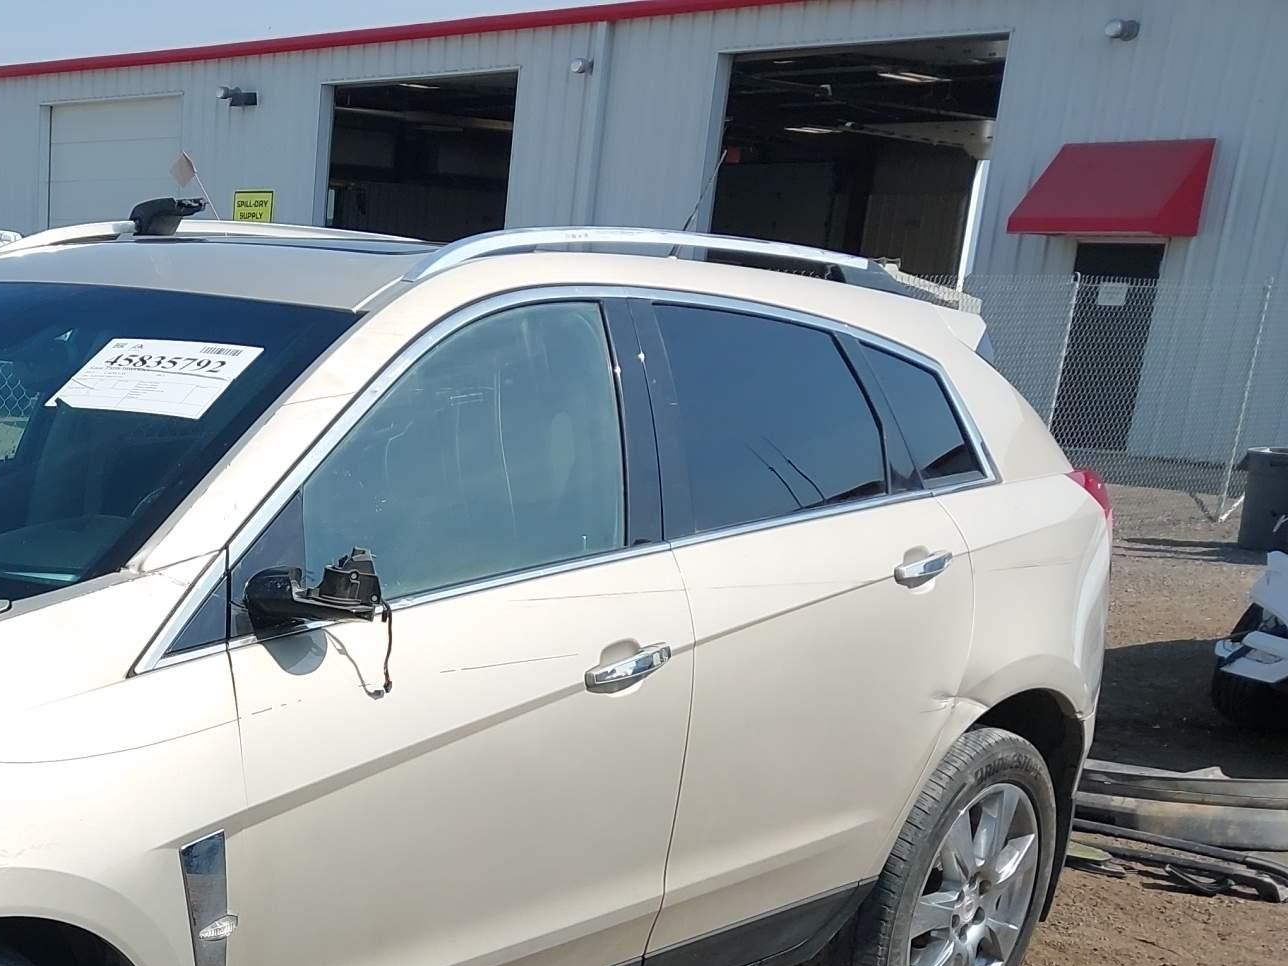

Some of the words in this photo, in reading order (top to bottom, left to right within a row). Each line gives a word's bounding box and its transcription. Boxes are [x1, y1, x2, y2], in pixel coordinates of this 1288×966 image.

[236, 200, 269, 208] SPILL-DRY
[239, 211, 264, 220] SUPPLY
[104, 353, 227, 374] 45835792
